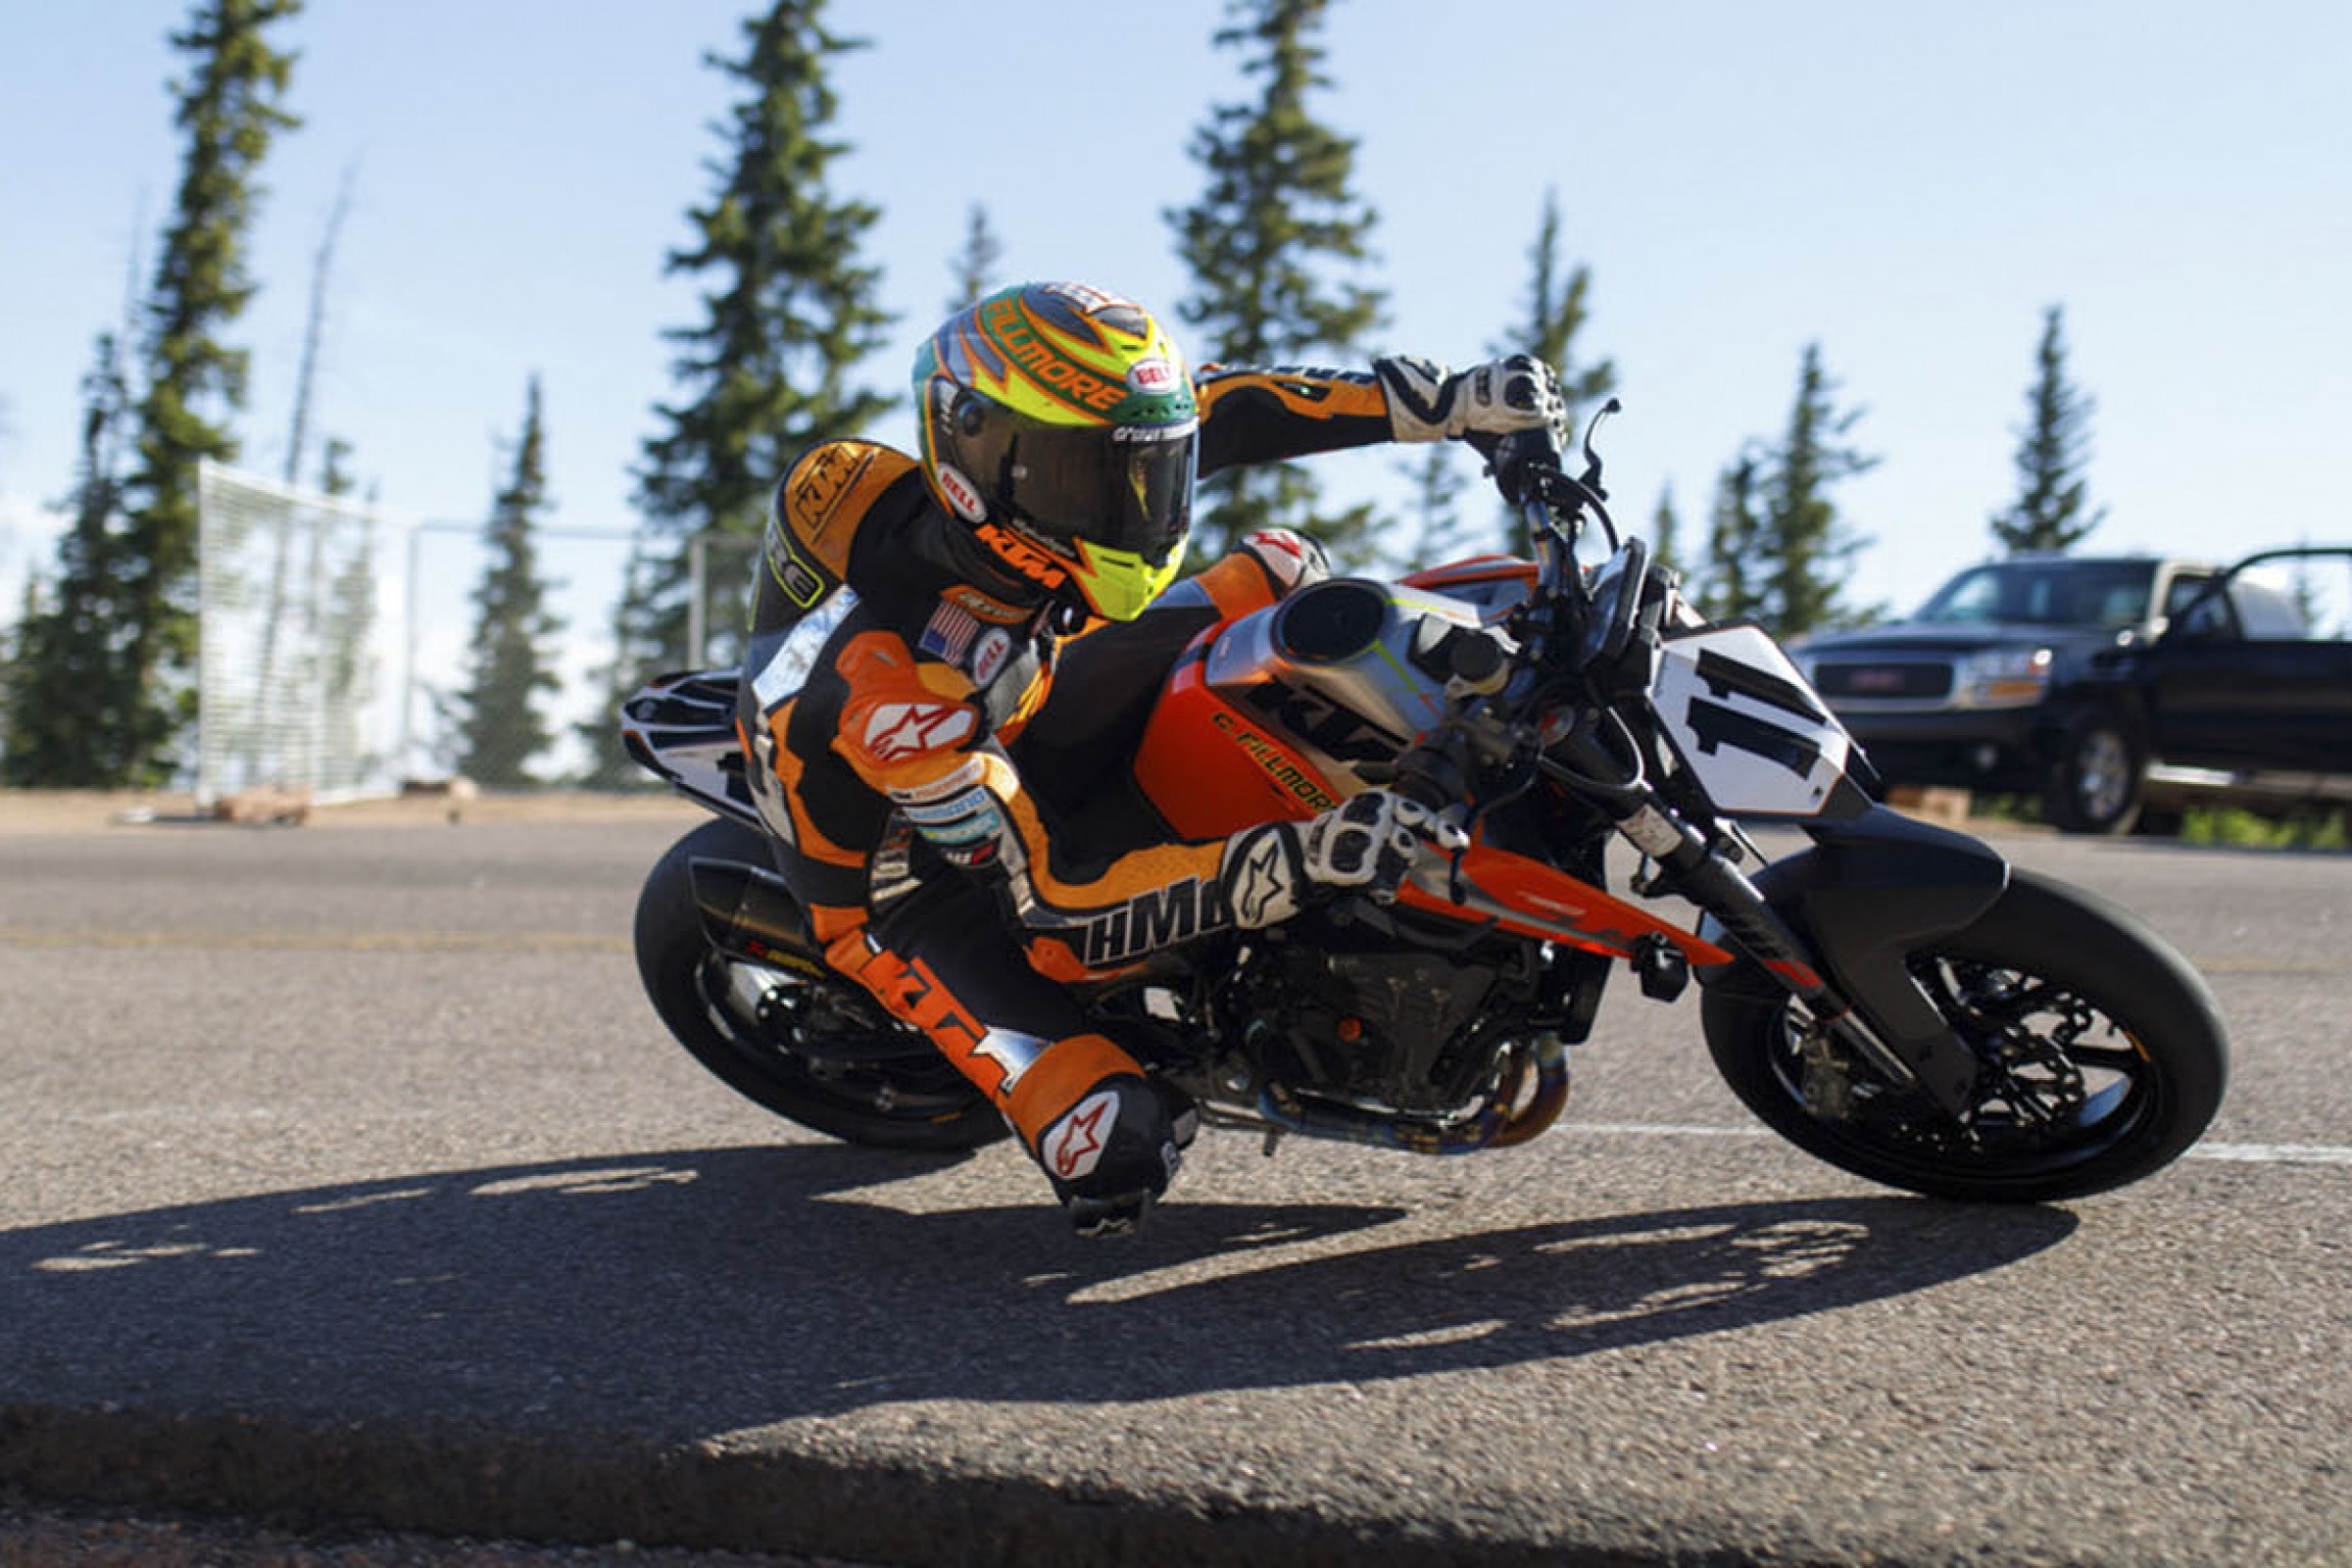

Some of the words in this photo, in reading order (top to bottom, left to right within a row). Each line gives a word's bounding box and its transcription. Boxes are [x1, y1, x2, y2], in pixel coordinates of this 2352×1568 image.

[985, 298, 1127, 411] FILLMORE
[795, 446, 862, 529] KTM
[941, 471, 976, 513] BELL
[974, 523, 1067, 589] KTM
[977, 638, 1004, 681] BELL
[1236, 731, 1339, 812] FILLMOR
